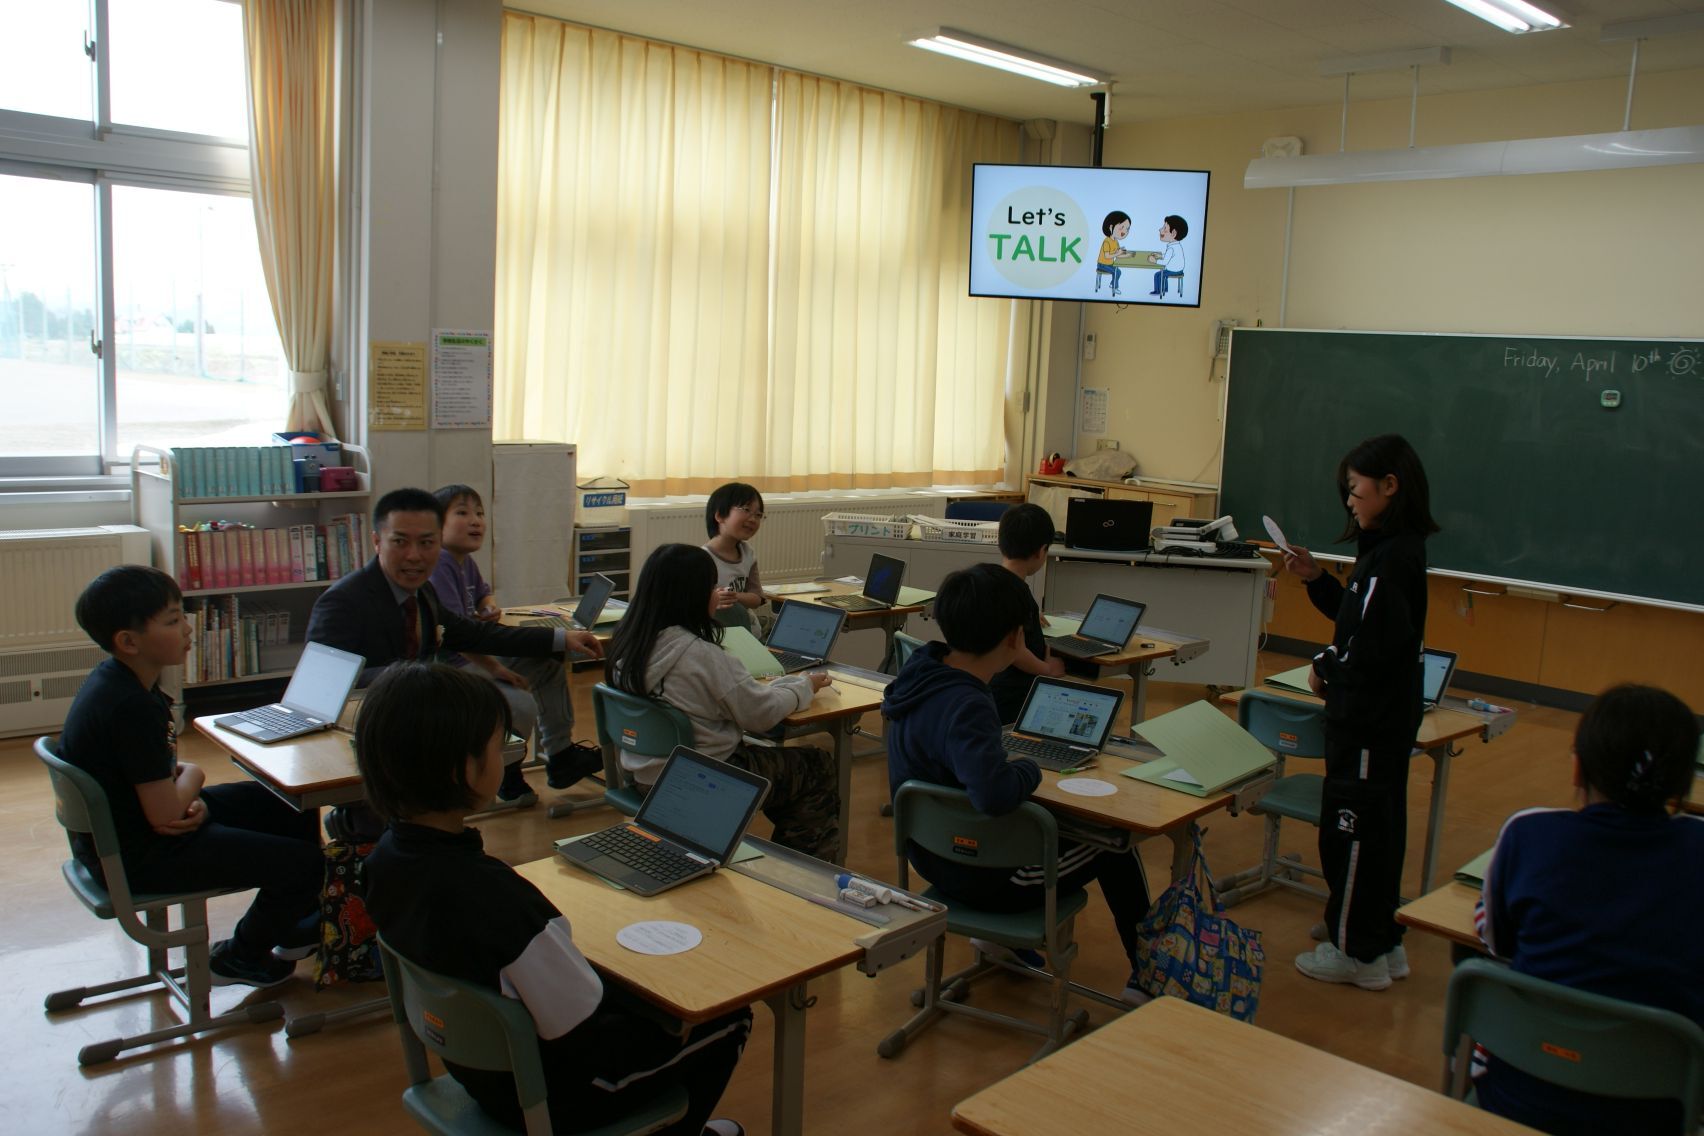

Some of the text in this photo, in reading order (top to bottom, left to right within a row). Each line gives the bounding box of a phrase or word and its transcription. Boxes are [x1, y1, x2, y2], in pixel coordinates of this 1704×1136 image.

[1008, 206, 1066, 227] Let's
[989, 233, 1082, 264] TALK
[1504, 347, 1662, 381] Friday, April 10th
[848, 524, 891, 537] プリント
[948, 531, 976, 540] 家庭学習
